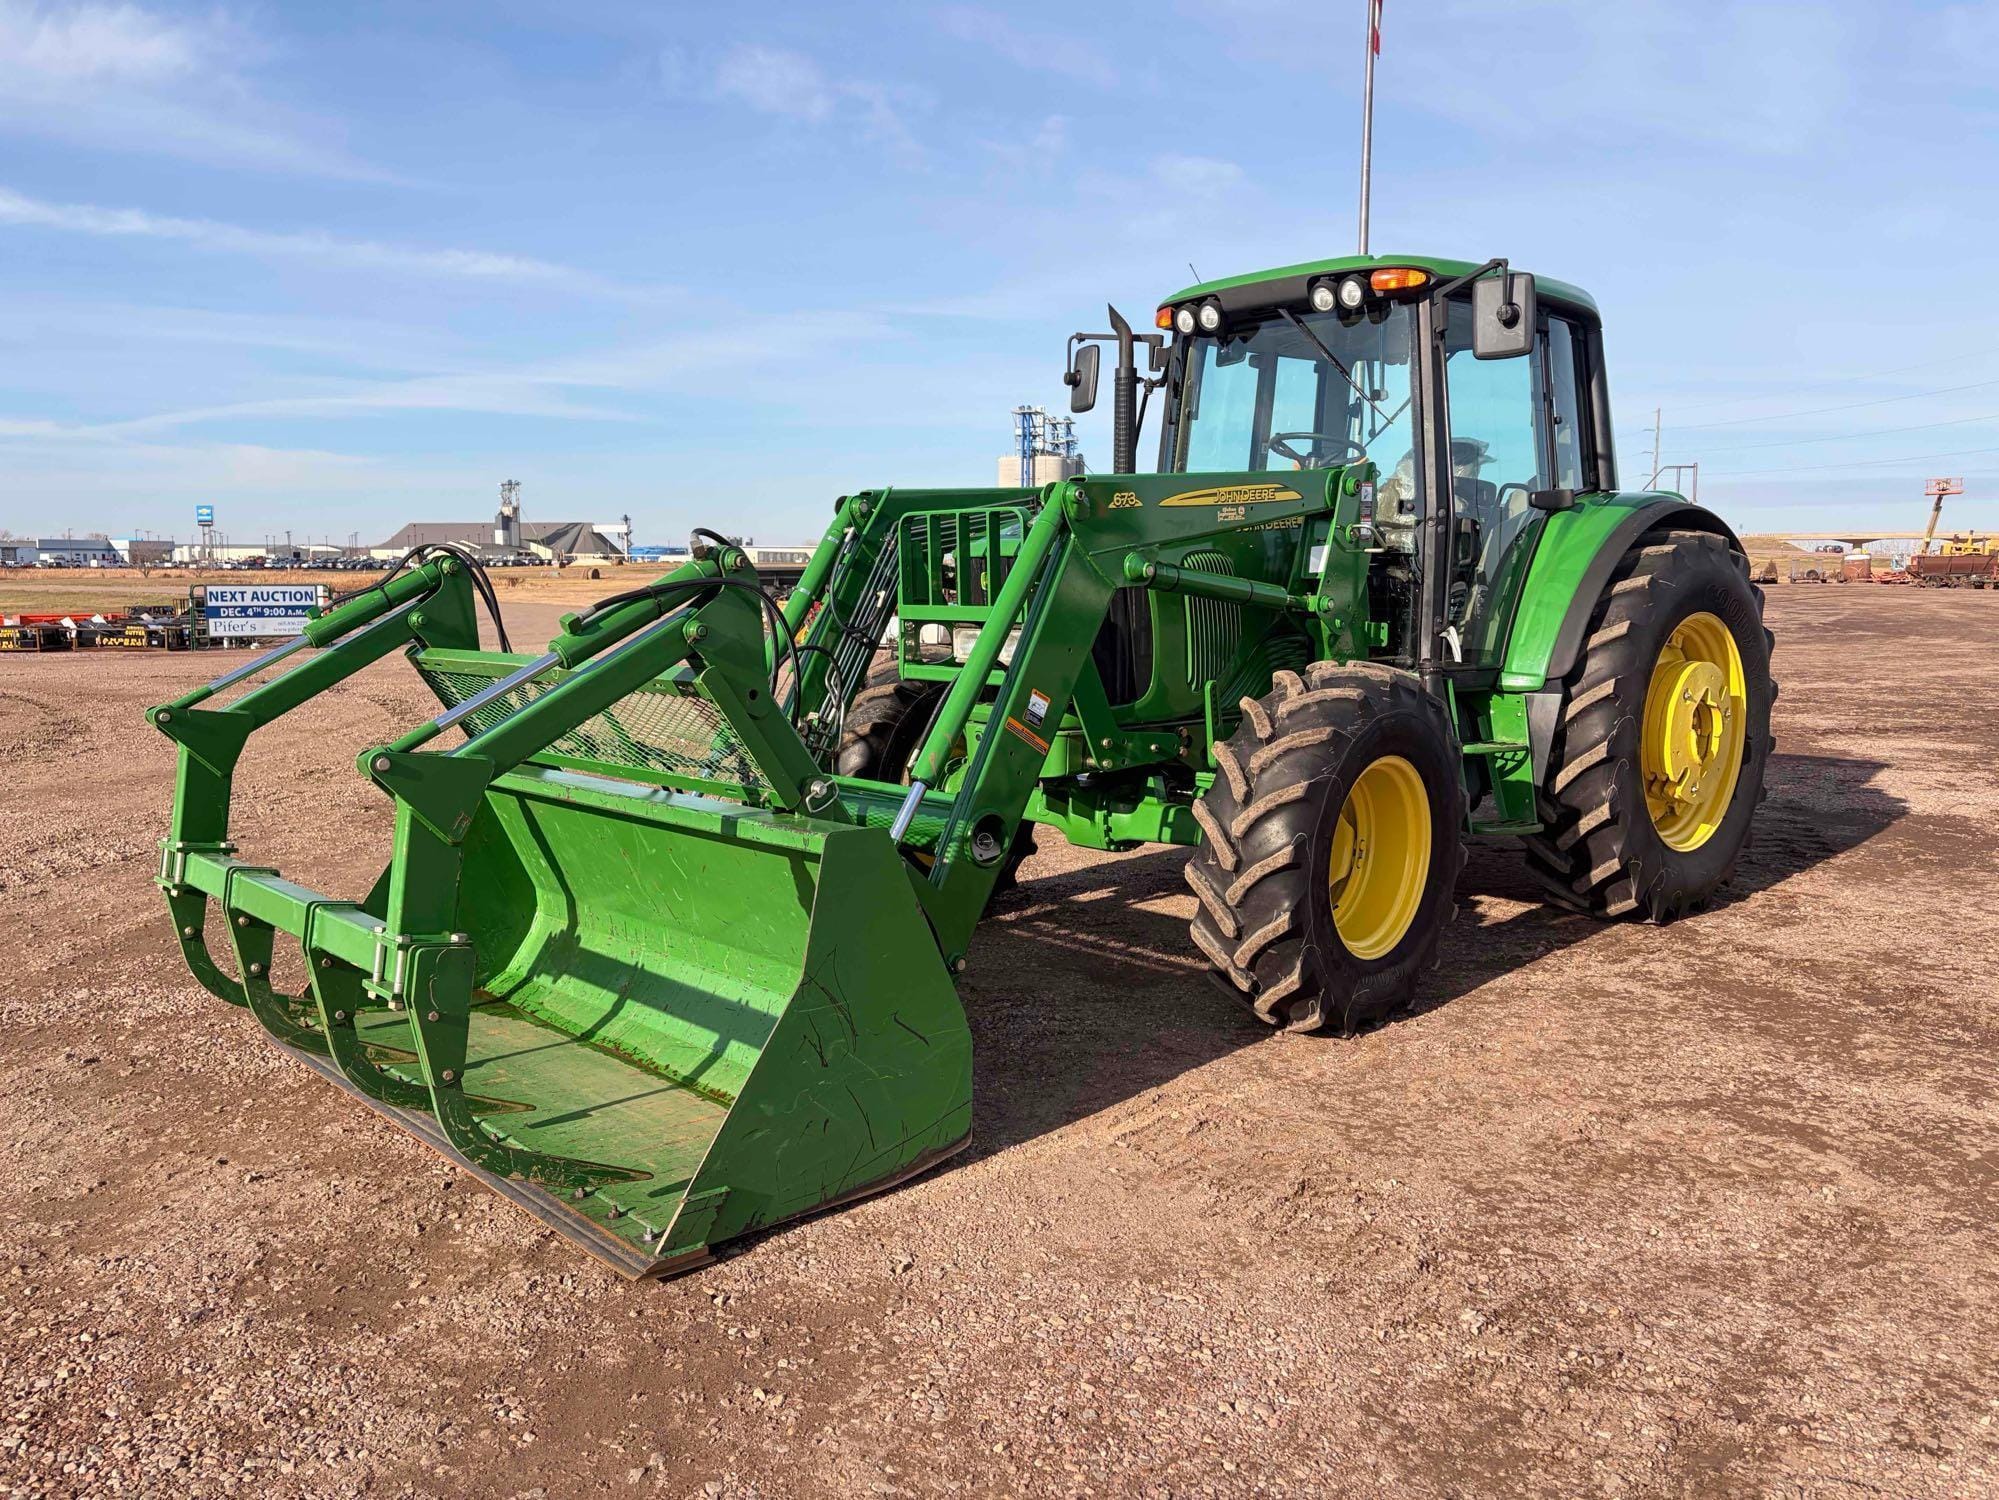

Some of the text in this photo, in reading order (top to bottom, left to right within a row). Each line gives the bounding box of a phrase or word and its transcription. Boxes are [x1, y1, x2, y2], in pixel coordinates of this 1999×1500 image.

[1113, 491, 1136, 506] 673
[1214, 488, 1276, 503] JOHN DEERE
[208, 590, 314, 602] NEXT AUCTION
[220, 607, 245, 617] DEC.
[246, 606, 262, 617] 4TH
[263, 607, 286, 617] 9:00
[213, 620, 257, 632] Pifer's
